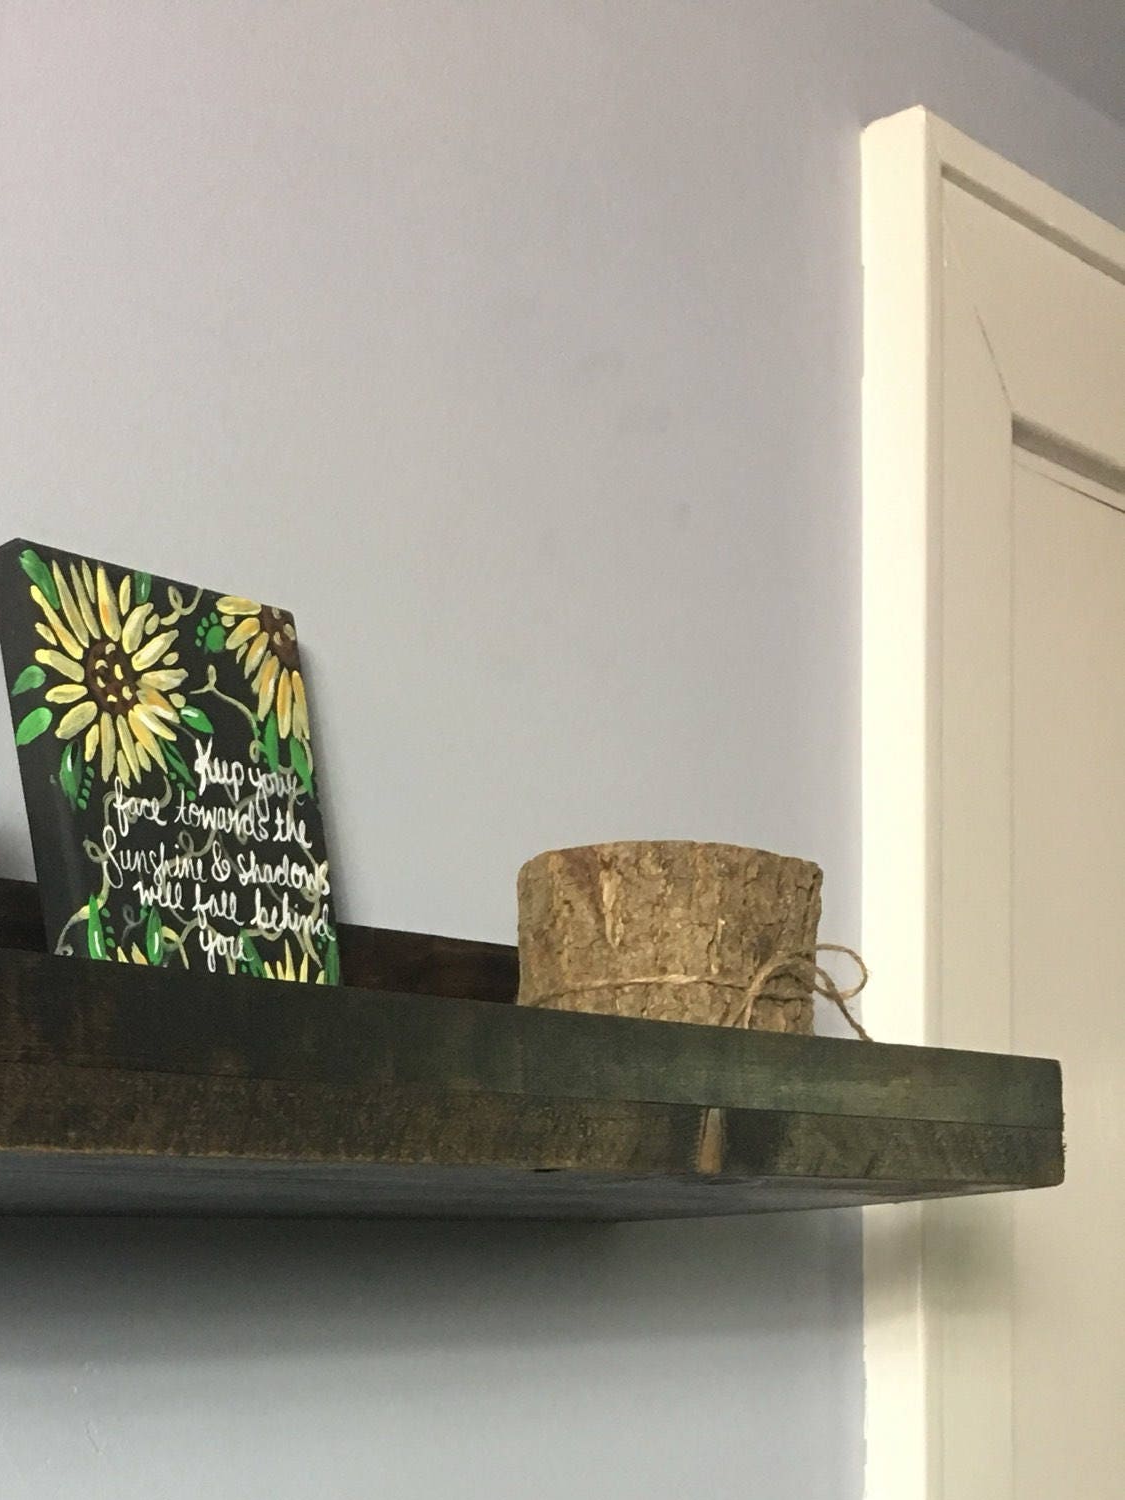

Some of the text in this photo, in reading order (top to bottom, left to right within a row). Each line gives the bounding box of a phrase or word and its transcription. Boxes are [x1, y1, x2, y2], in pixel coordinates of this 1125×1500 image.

[194, 736, 298, 822] Keep your
[114, 776, 313, 849] face towards the
[211, 840, 231, 882] &
[132, 880, 337, 942] will fall behind
[199, 929, 254, 973] you
